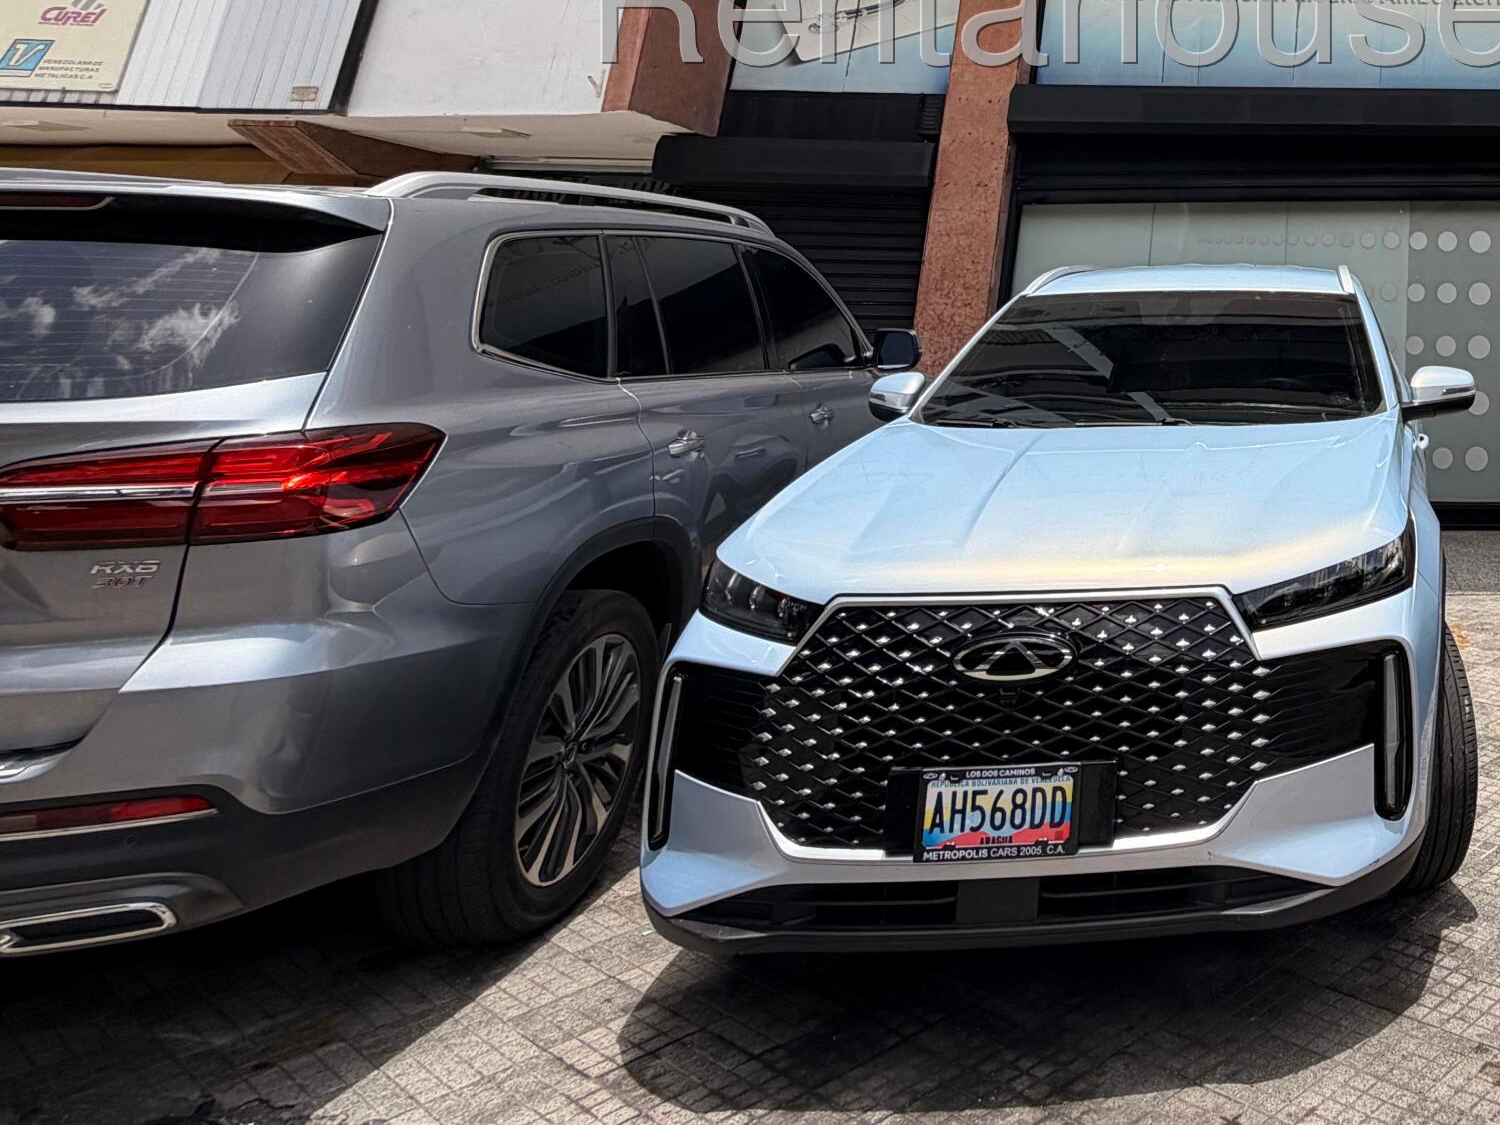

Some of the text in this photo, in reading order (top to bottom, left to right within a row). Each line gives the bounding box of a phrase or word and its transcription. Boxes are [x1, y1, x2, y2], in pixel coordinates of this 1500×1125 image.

[982, 770, 998, 778] DOS
[999, 768, 1035, 777] CAMINOS
[972, 777, 1018, 787] BOLIVARIANA
[1020, 776, 1029, 784] DE
[929, 786, 1067, 833] AH568DD
[980, 835, 1013, 845] ARAGUA
[923, 849, 988, 861] METROPOLIS
[990, 847, 1018, 858] CARS
[1046, 845, 1066, 854] C.A.
